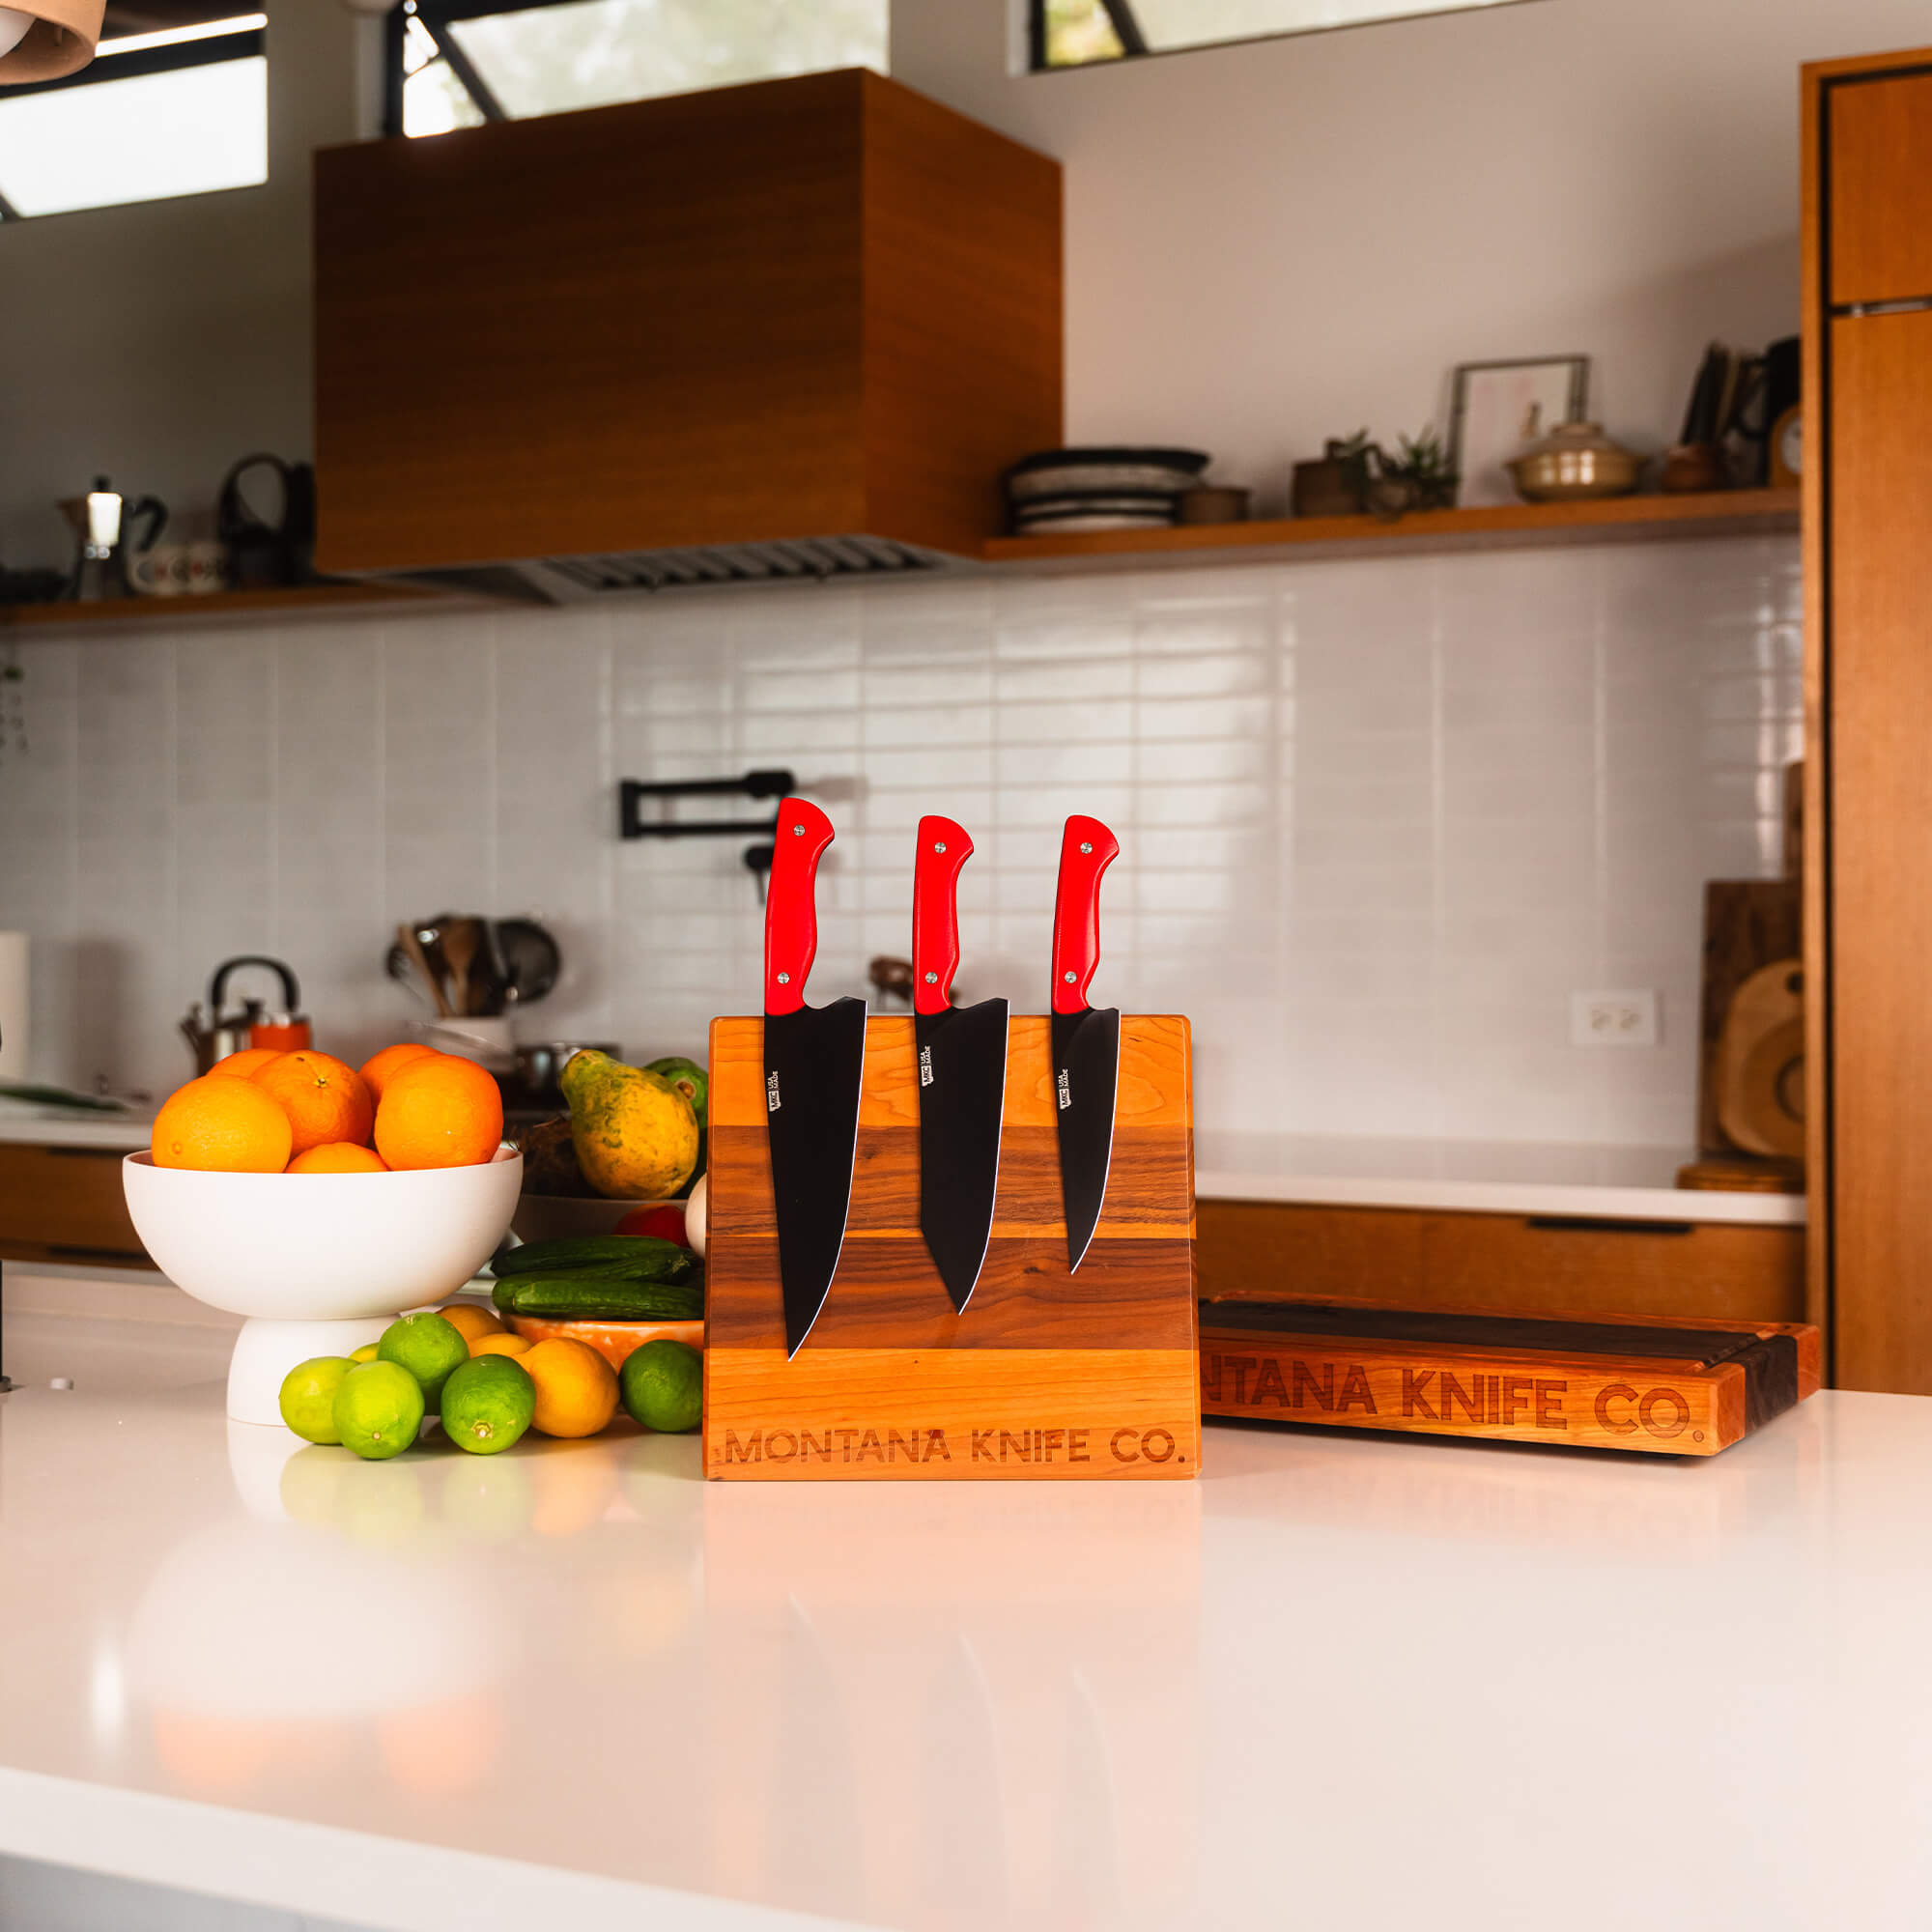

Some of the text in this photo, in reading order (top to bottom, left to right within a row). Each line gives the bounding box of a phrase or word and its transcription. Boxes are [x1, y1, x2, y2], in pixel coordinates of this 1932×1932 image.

[1402, 1368, 1567, 1431] KNIFE
[725, 1428, 1185, 1463] MONTANA KNIFE CO.
